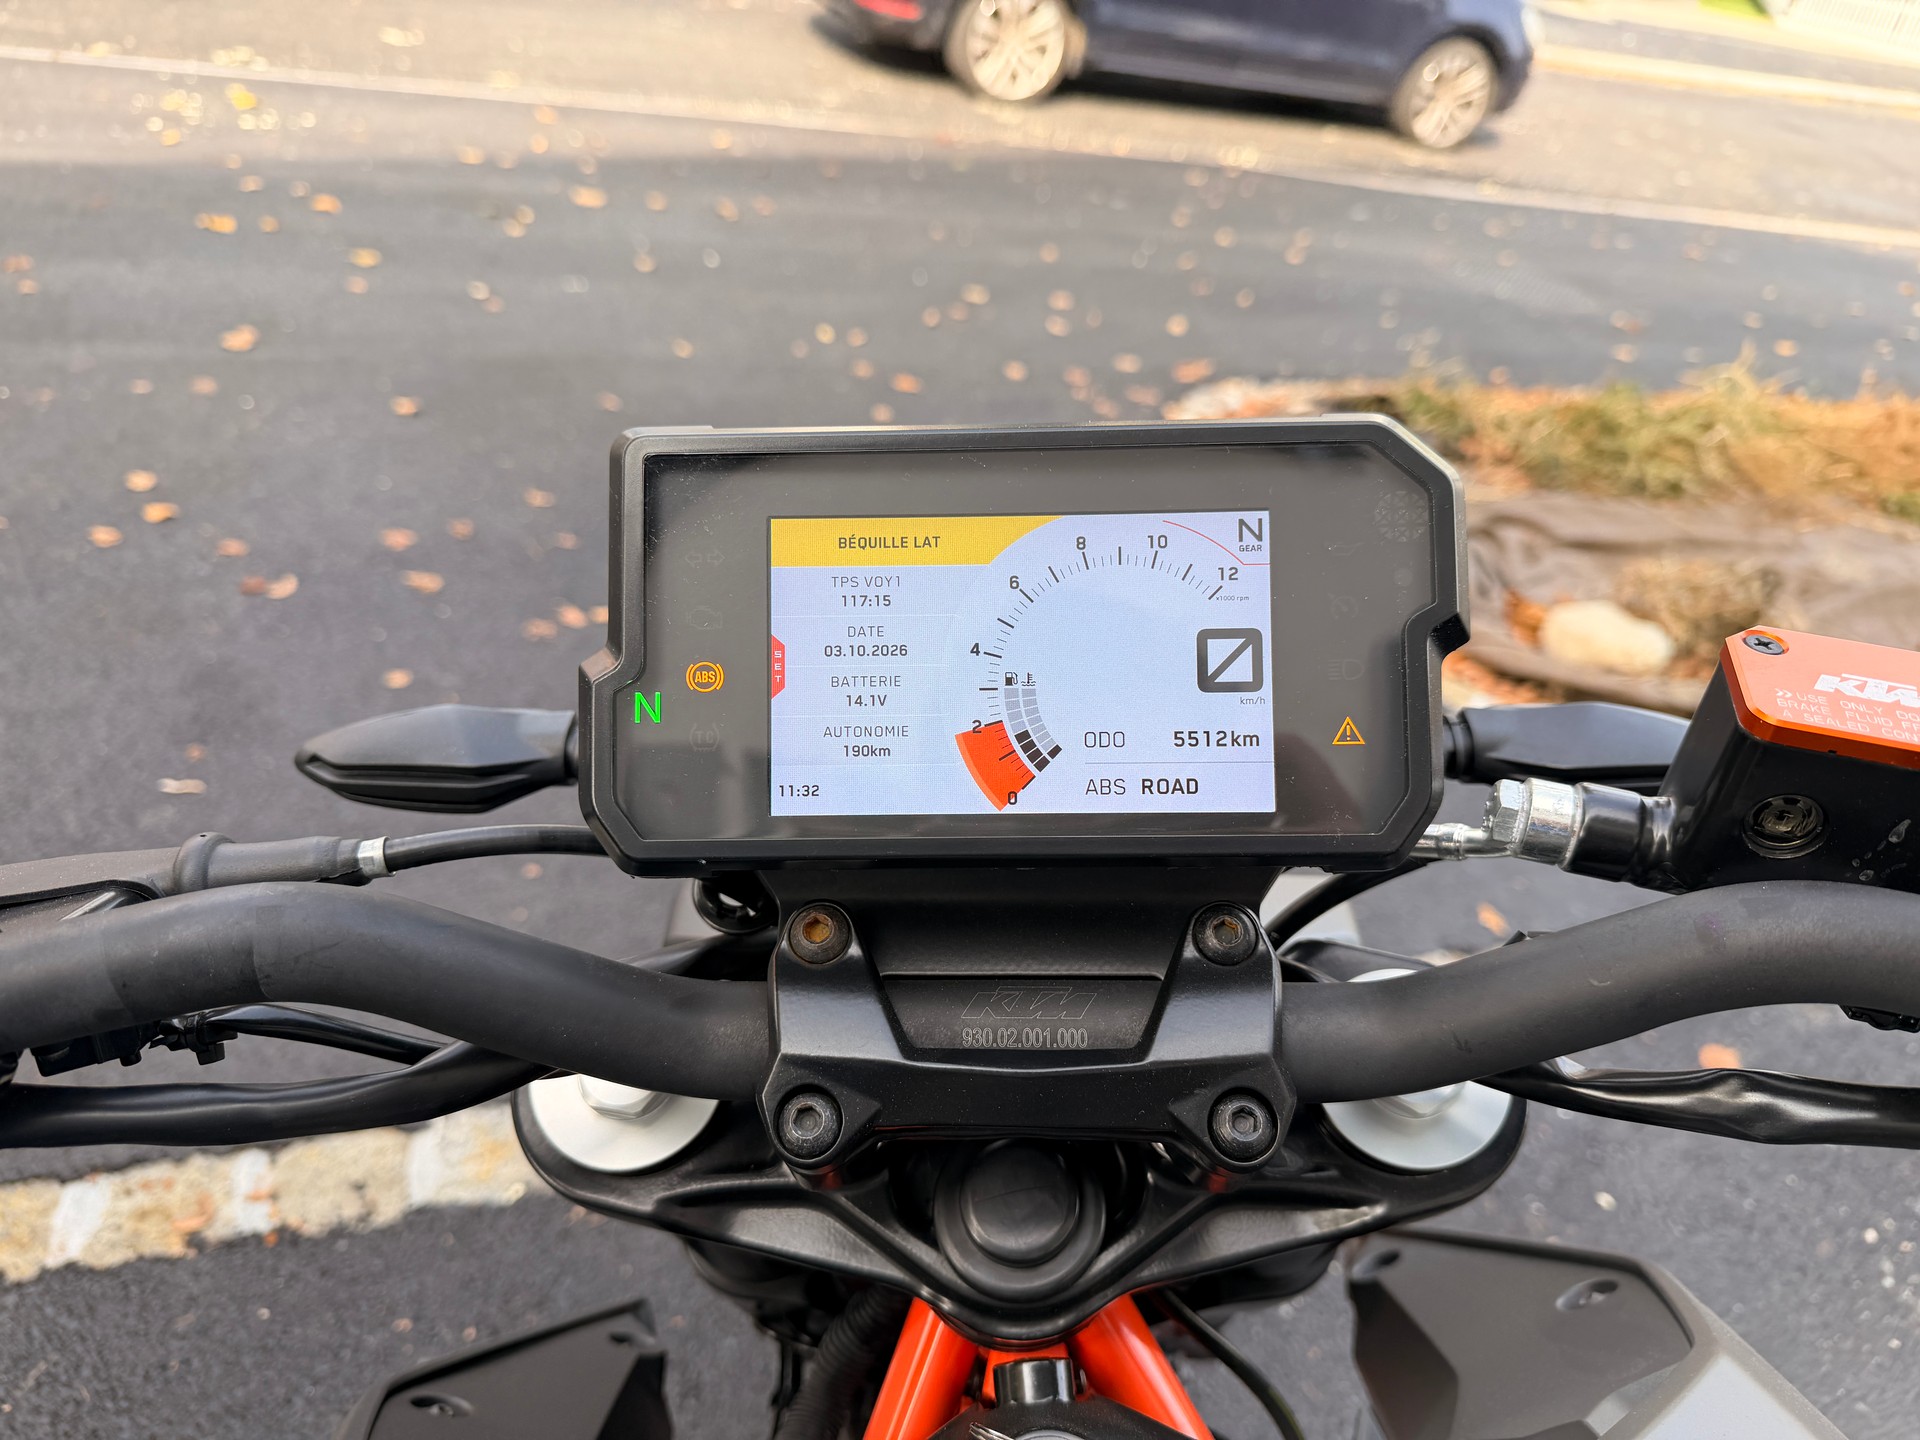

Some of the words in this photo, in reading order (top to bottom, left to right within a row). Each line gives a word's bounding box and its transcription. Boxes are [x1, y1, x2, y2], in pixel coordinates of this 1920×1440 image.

[1238, 518, 1262, 542] N
[838, 534, 908, 549] BÉQUILLE
[913, 536, 941, 548] LAT
[1076, 536, 1086, 550] 8
[1148, 535, 1168, 549] 10
[1218, 567, 1239, 581] 12
[832, 576, 859, 588] TPS
[1009, 576, 1020, 590] 6
[842, 595, 891, 607] 117:15
[847, 626, 884, 638] DATE
[824, 645, 908, 657] 03.10.2026
[970, 643, 980, 656] 4
[695, 671, 716, 683] ABS
[831, 676, 901, 688] BATTERIE
[634, 691, 661, 724] N
[847, 695, 887, 707] 14.1V
[1240, 697, 1266, 705] km/h
[1796, 692, 1828, 705] USE
[1840, 700, 1883, 715] ONLY
[1777, 698, 1831, 716] BRAKE
[1845, 710, 1893, 727] FLUID
[972, 720, 982, 733] 2
[1783, 709, 1792, 718] A
[1804, 713, 1870, 732] SEALED
[823, 725, 909, 738] AUTONOMIE
[1084, 731, 1126, 748] ODO
[1173, 730, 1260, 747] 5512km
[844, 745, 891, 757] 190km
[779, 785, 820, 797] 11:32
[1085, 779, 1126, 795] ABS
[1141, 778, 1199, 795] ROAD
[1008, 791, 1017, 805] 0
[961, 986, 1097, 1019] KTM
[962, 1027, 1088, 1048] 930.02.001.000
